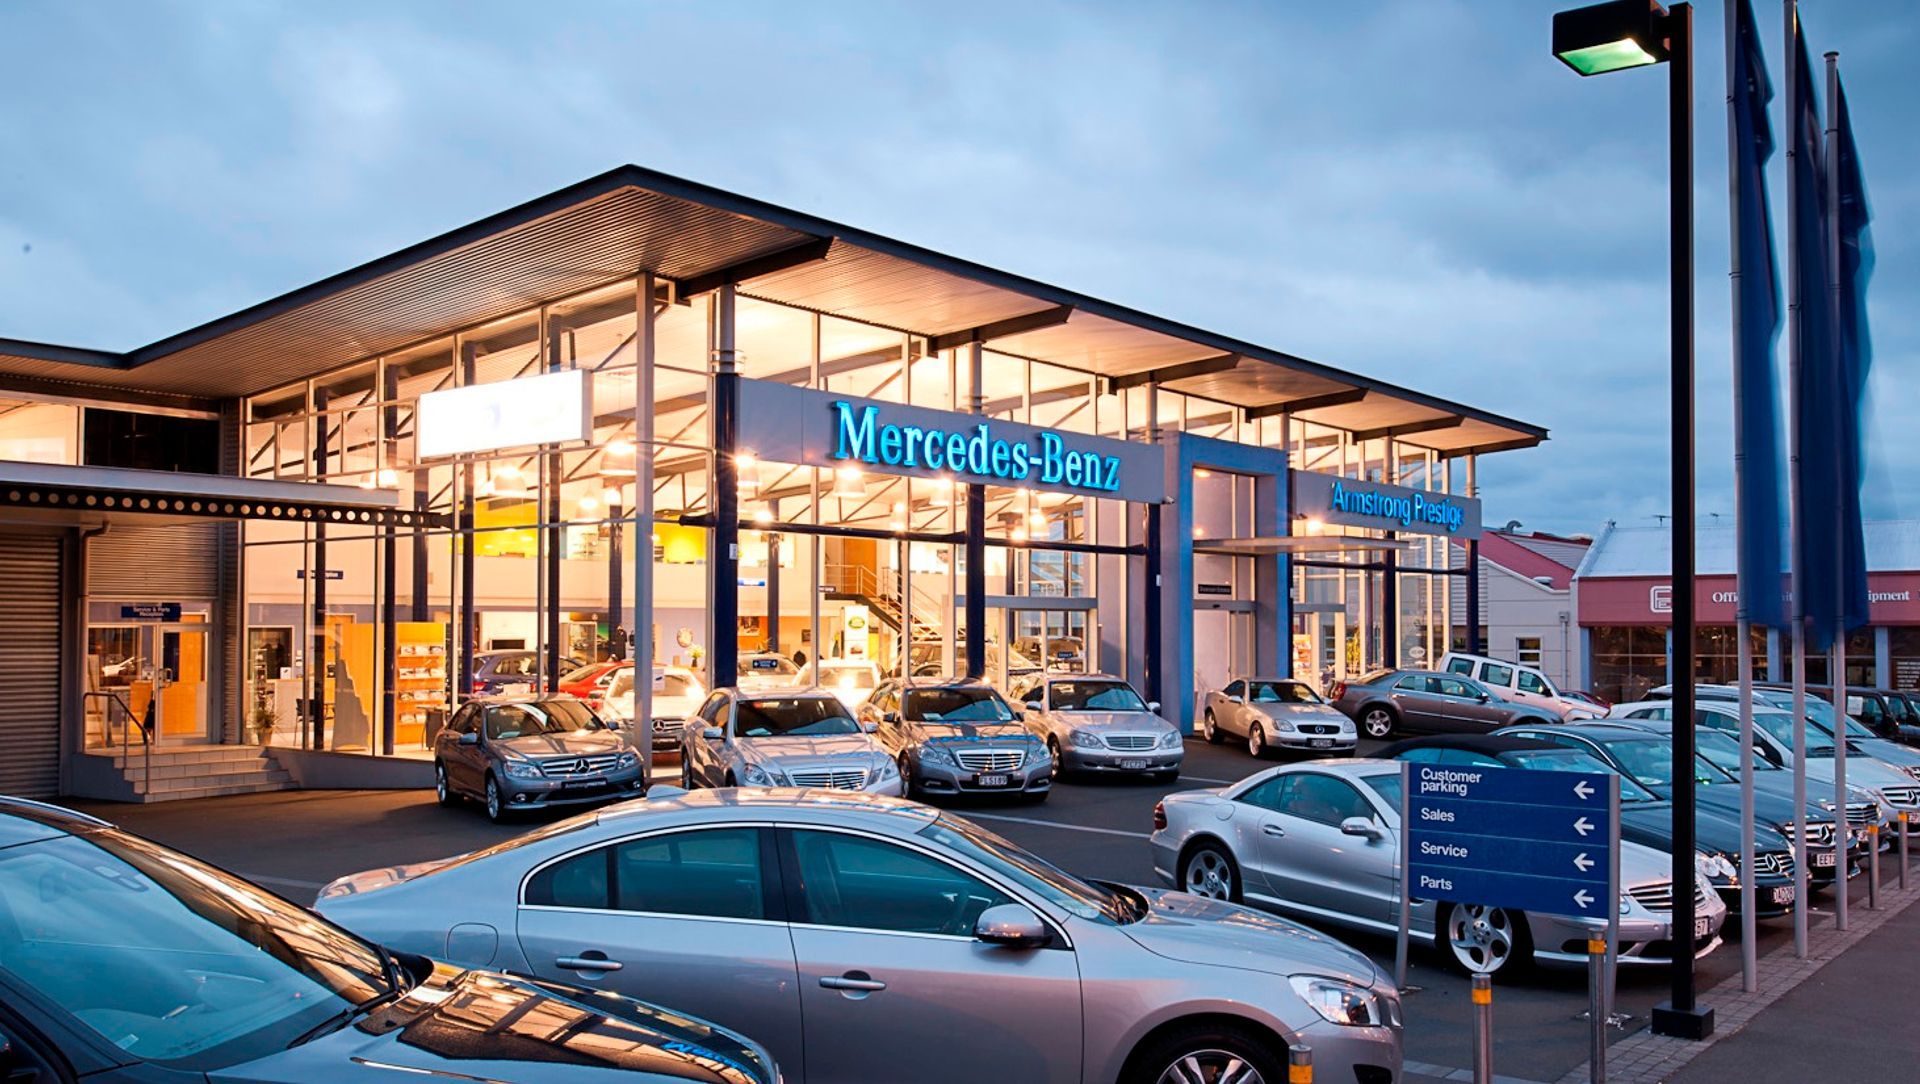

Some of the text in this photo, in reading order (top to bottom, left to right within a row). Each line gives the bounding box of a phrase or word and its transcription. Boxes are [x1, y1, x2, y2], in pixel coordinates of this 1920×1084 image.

[832, 400, 1121, 491] Mercedes-Benz
[1331, 481, 1465, 532] Armstrong Prestige
[1712, 590, 1910, 604] Offi ipment
[1420, 767, 1482, 783] Customer
[1420, 781, 1467, 797] parking
[1420, 807, 1455, 822] Sales
[1420, 841, 1468, 858] Service
[1420, 875, 1453, 890] Parts
